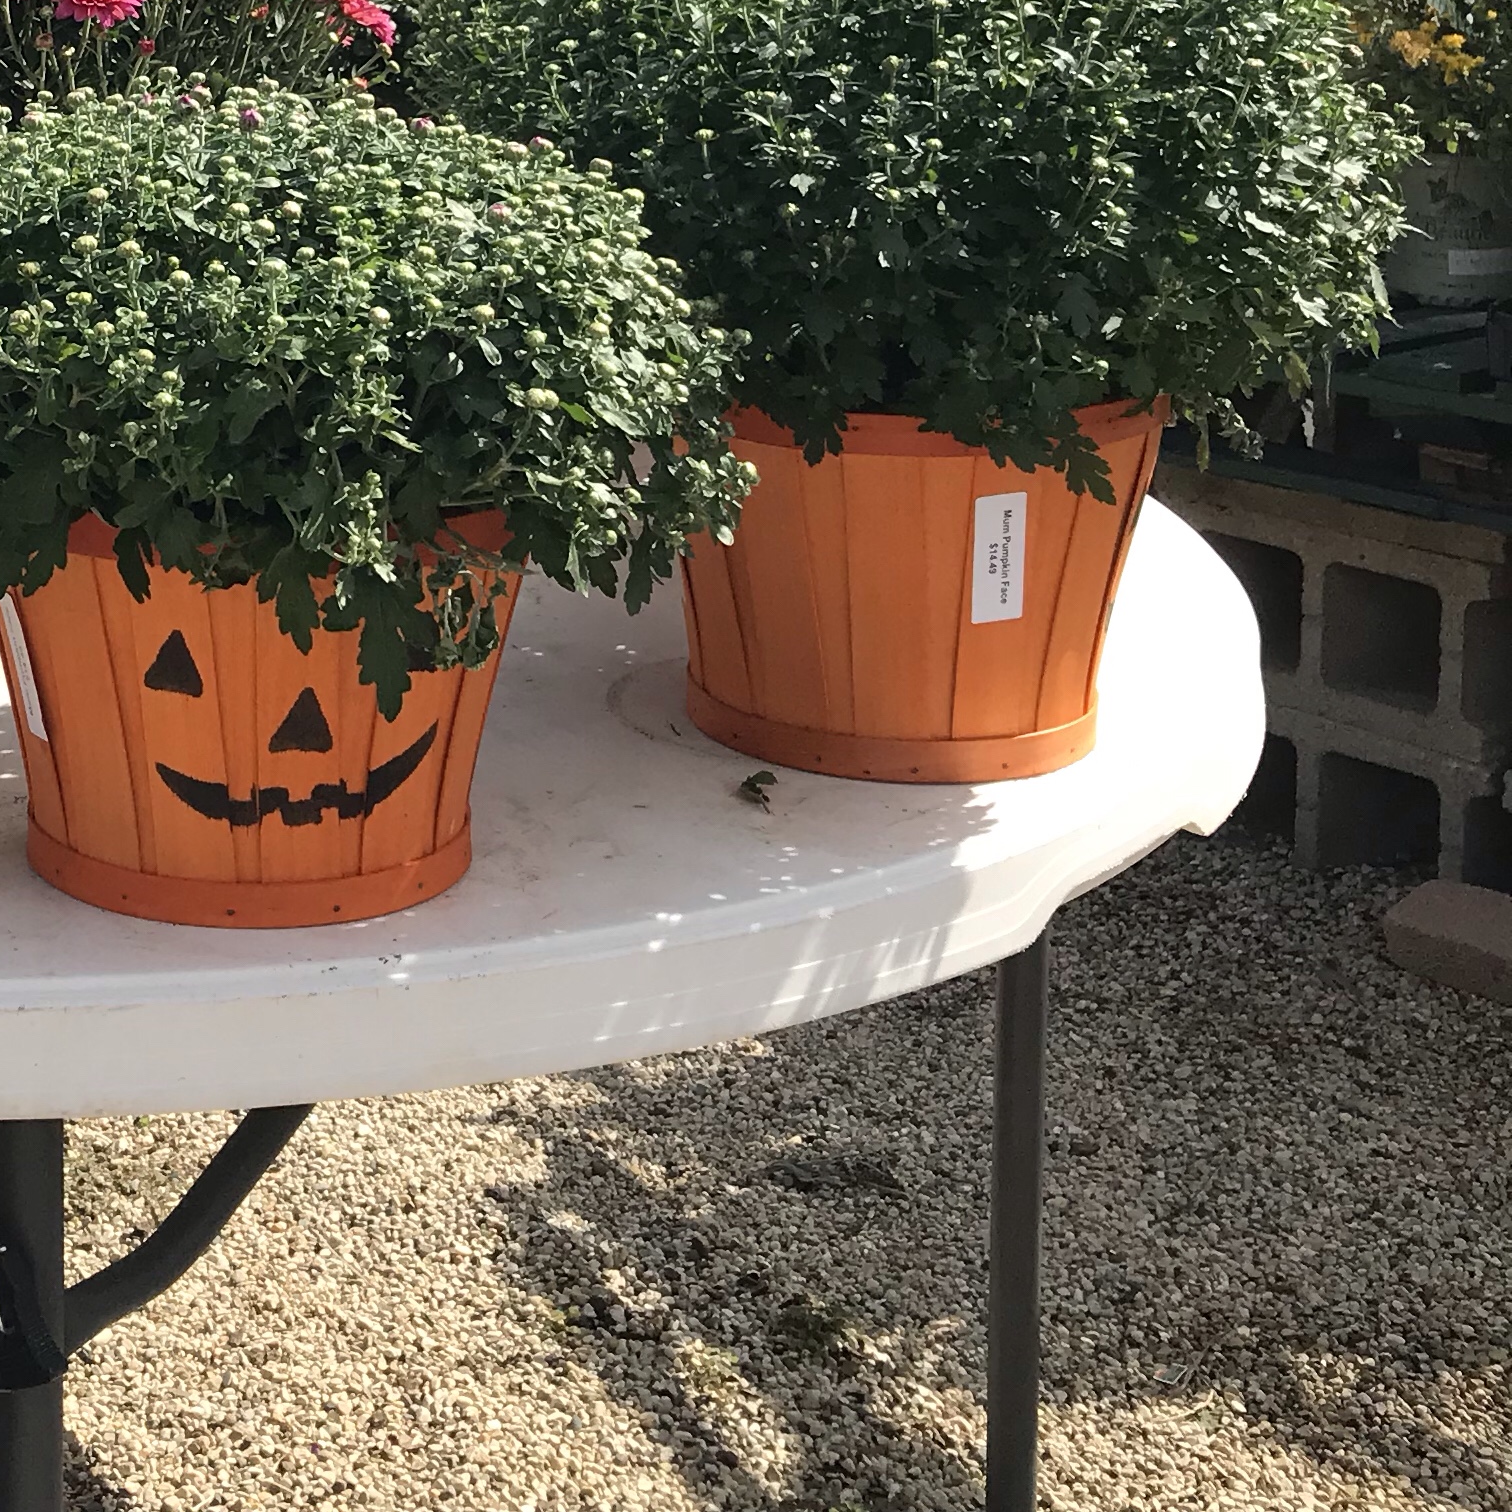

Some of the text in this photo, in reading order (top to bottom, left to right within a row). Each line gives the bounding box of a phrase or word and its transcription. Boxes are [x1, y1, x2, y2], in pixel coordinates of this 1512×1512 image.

[1000, 509, 1012, 604] Mum Pumpkin Face
